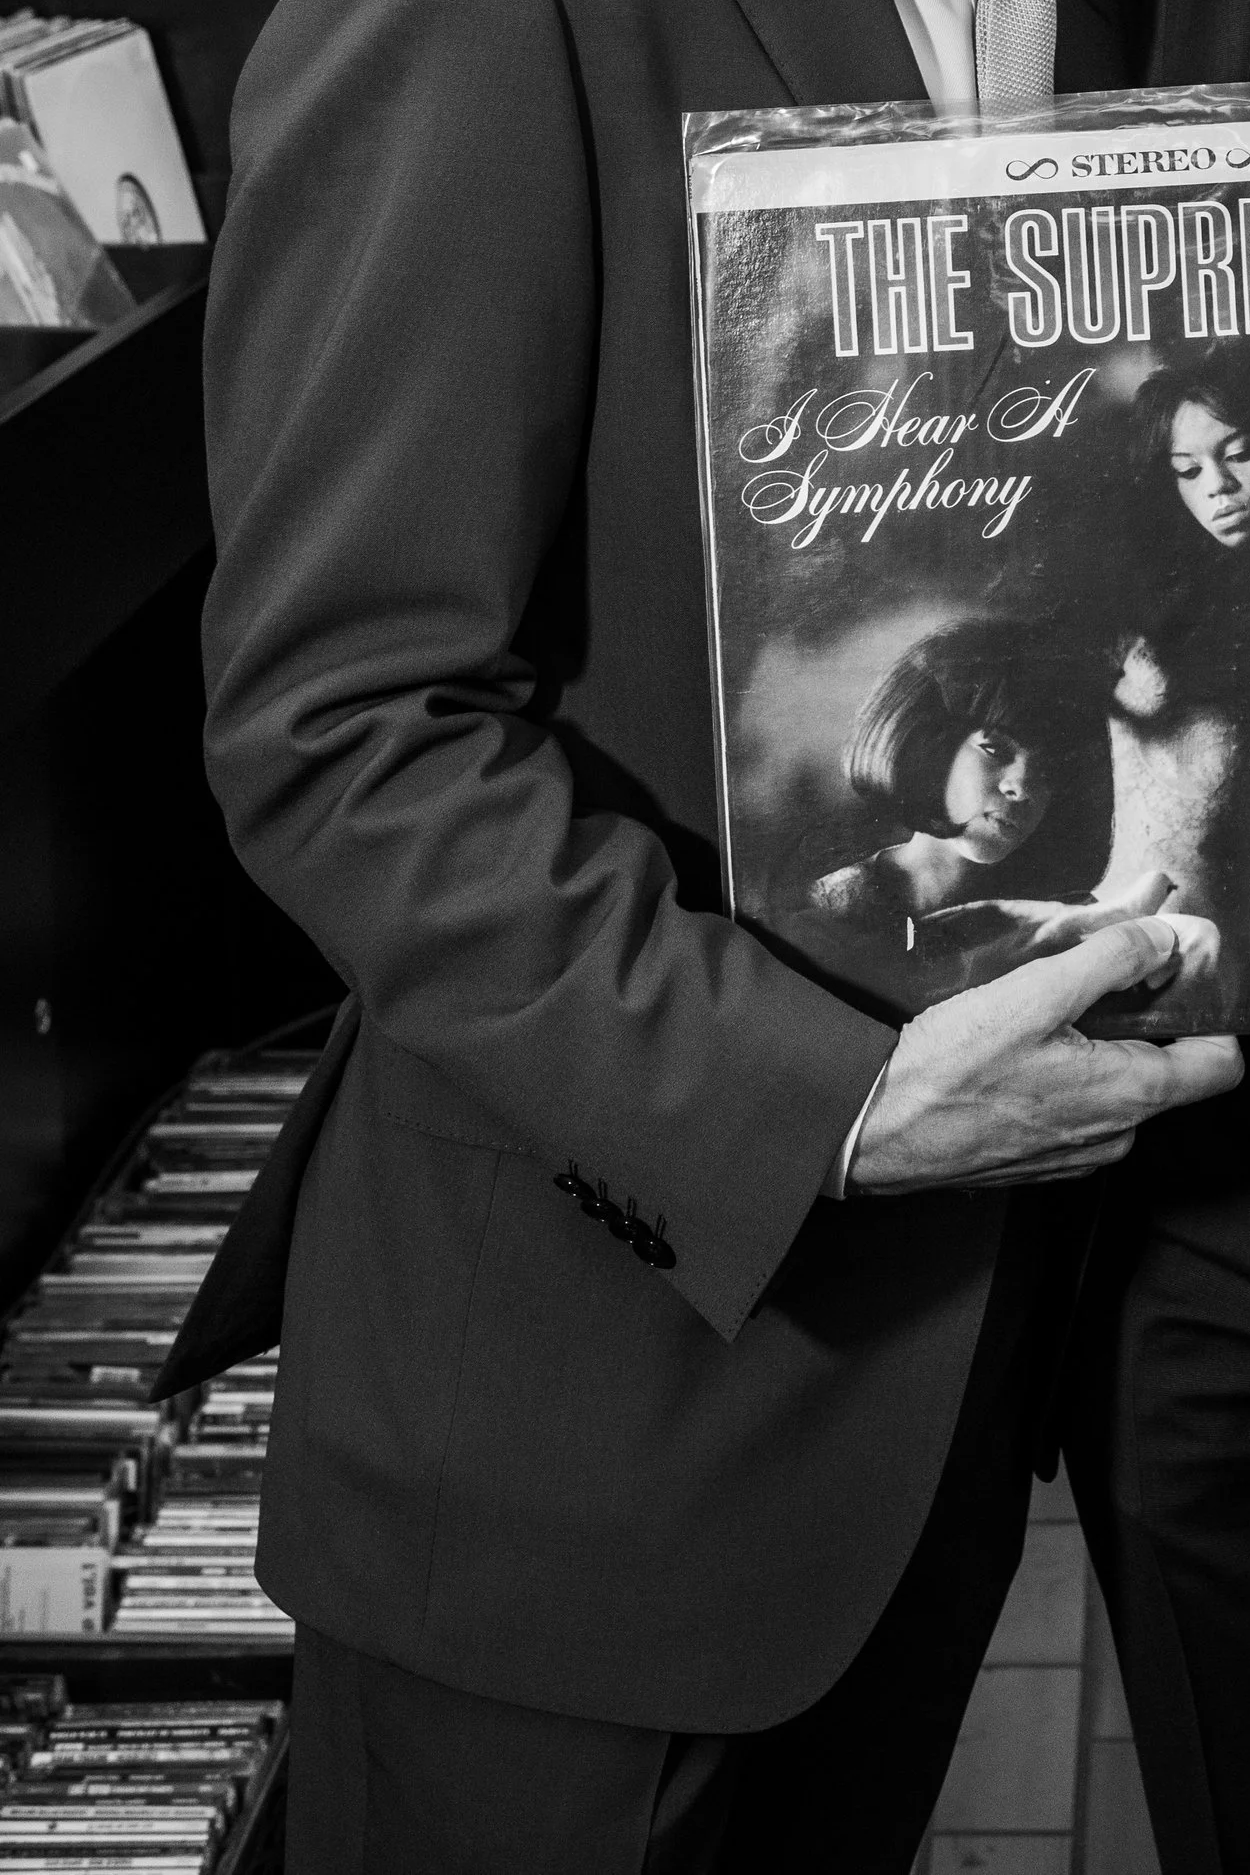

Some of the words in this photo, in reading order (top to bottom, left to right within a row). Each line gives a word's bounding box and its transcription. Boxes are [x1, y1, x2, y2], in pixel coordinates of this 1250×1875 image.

[1071, 147, 1217, 178] STEREO
[815, 214, 974, 357] THE
[738, 388, 818, 463] I
[815, 371, 979, 452] Hear
[986, 368, 1097, 442] A
[741, 448, 1033, 550] Symphony
